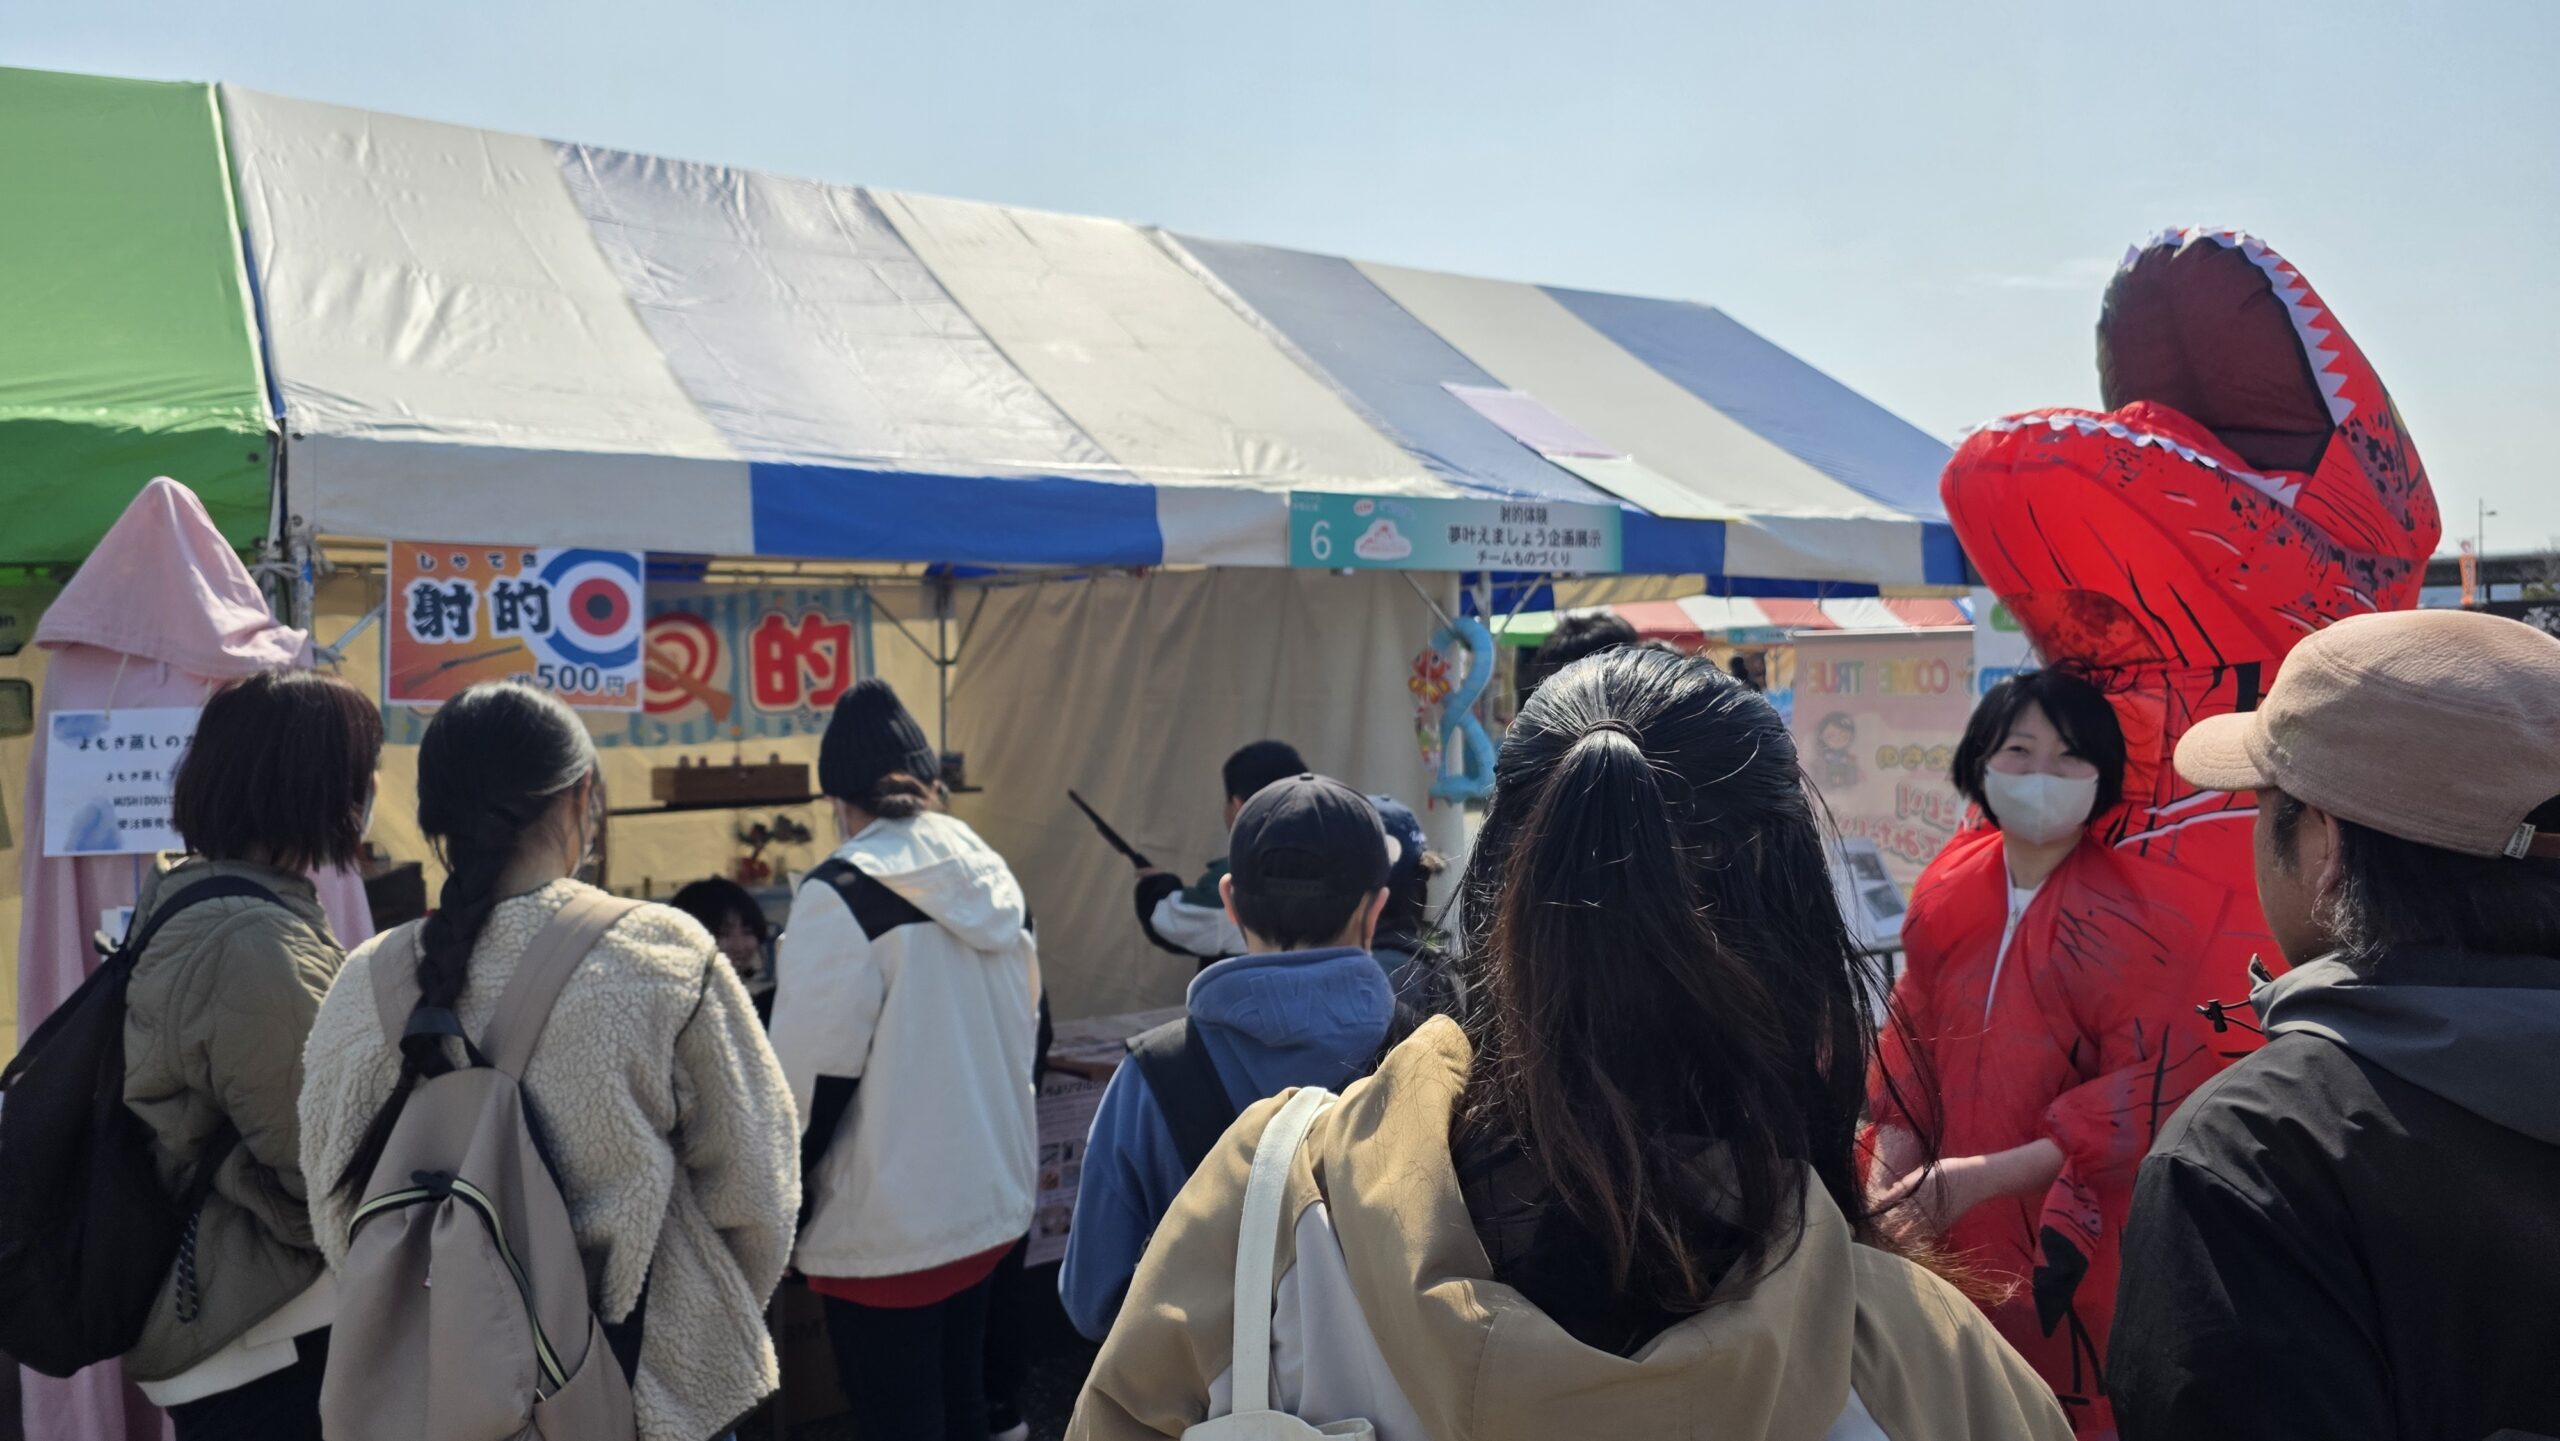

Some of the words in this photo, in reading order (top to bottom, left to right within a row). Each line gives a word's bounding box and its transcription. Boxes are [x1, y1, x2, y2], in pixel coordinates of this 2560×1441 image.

[1501, 505, 1548, 525] 射的体験
[1311, 520, 1332, 561] 6
[1448, 526, 1601, 548] 夢叶えましょう企画展示
[1477, 550, 1570, 567] チームものづくり
[412, 582, 552, 638] 射的
[754, 613, 852, 706] 的
[106, 770, 174, 783] よもぎ蒸し
